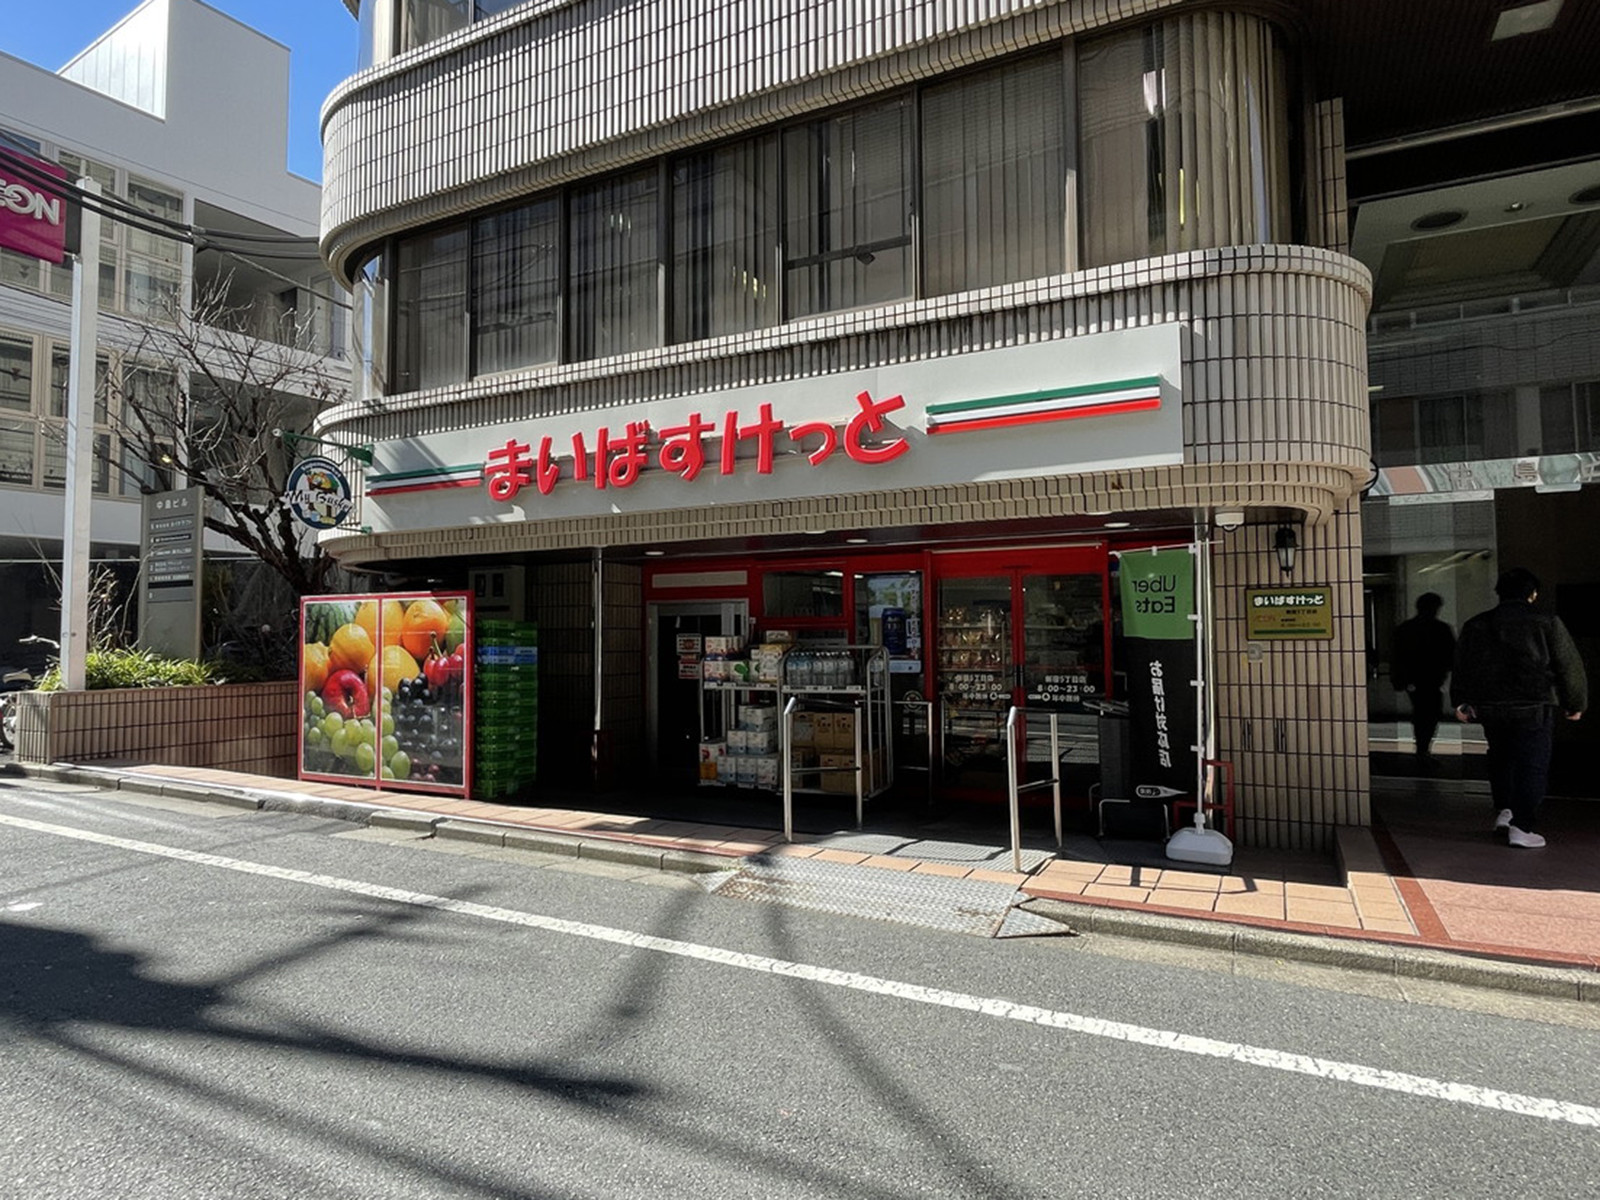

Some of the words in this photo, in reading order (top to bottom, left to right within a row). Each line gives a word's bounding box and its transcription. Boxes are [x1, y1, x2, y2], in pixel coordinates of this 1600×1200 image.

[485, 390, 910, 501] まいばすけっと
[285, 489, 311, 505] My
[1254, 594, 1324, 607] まいばすけっと
